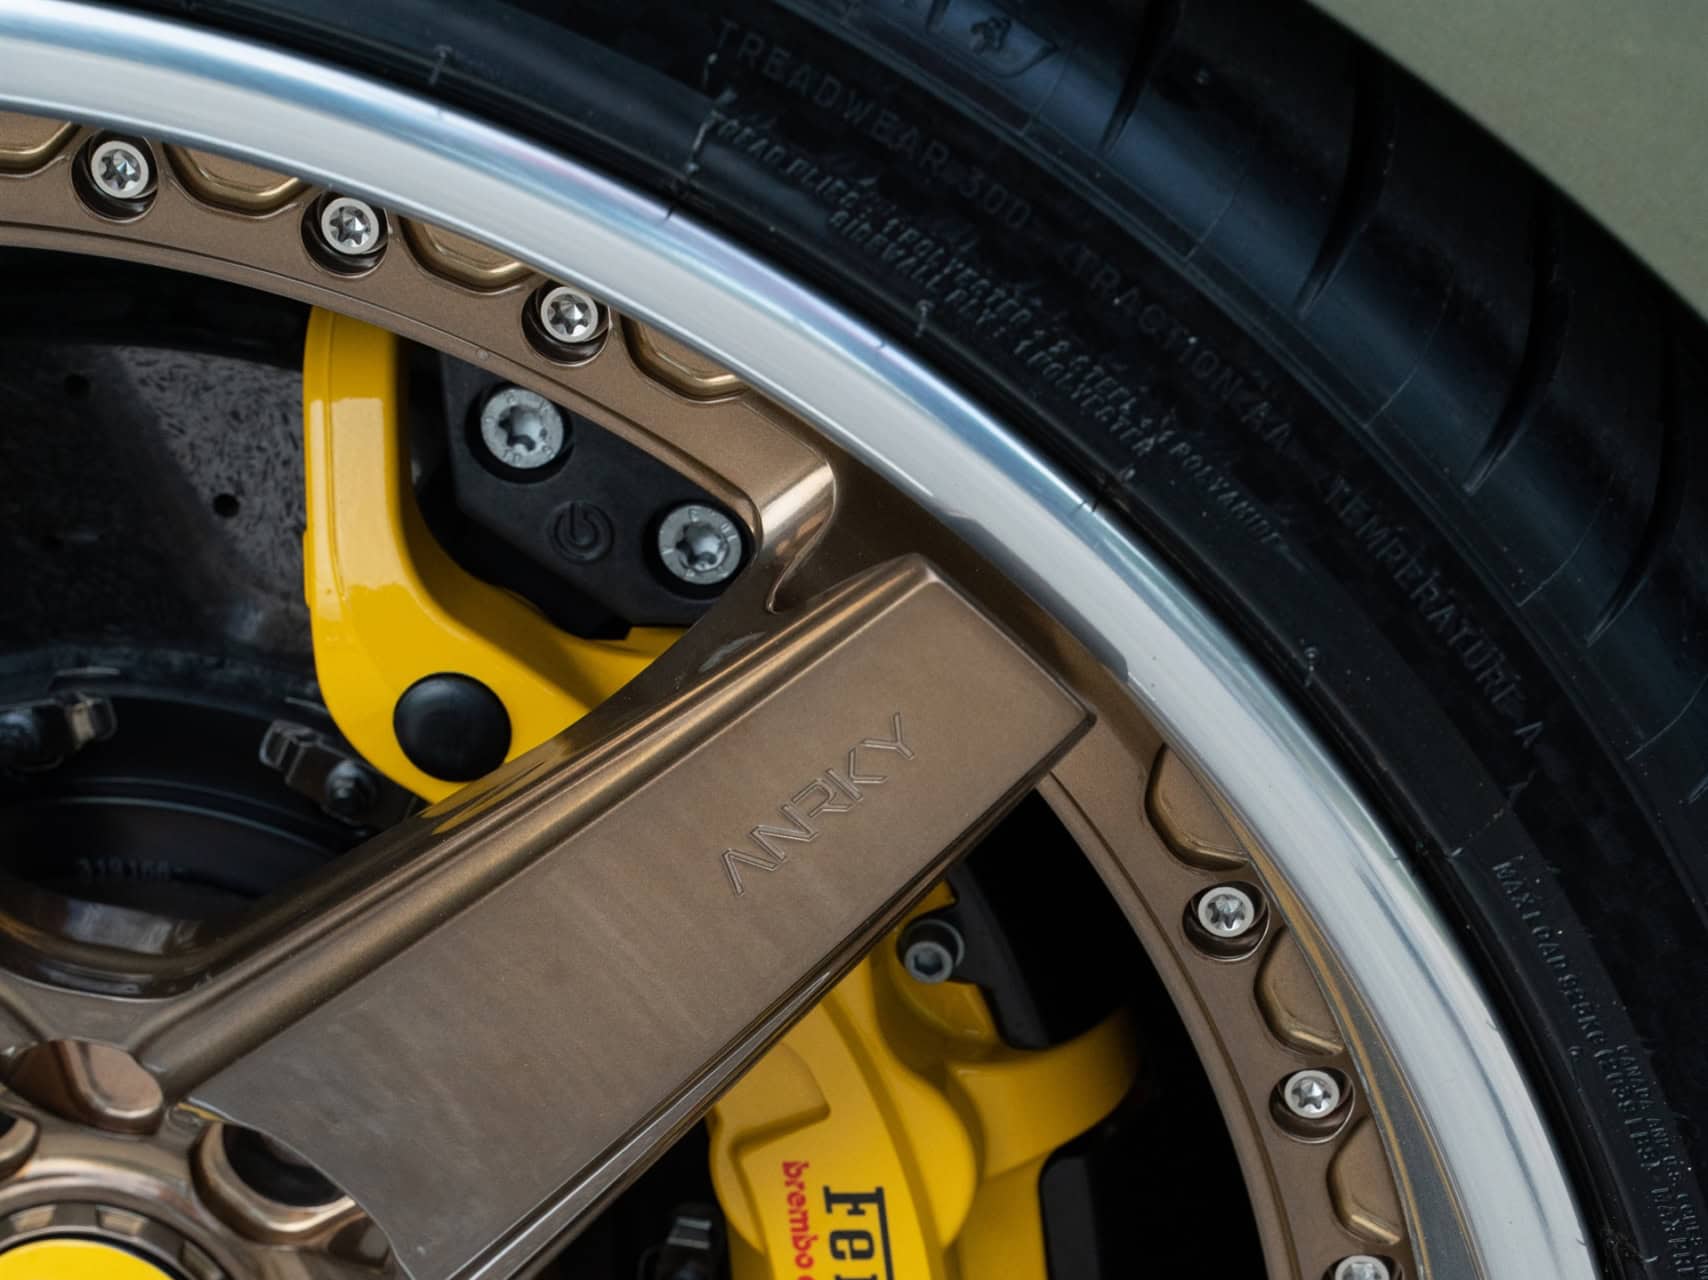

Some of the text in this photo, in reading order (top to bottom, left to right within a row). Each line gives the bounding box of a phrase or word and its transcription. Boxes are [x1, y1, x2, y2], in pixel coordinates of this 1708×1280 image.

[714, 19, 950, 177] TREADWEAR
[961, 168, 1033, 227] 300
[1071, 245, 1244, 401] TRACTION
[1324, 477, 1528, 713] TEMPERATURE
[720, 711, 917, 897] ANRKY
[782, 1161, 818, 1270] brembo
